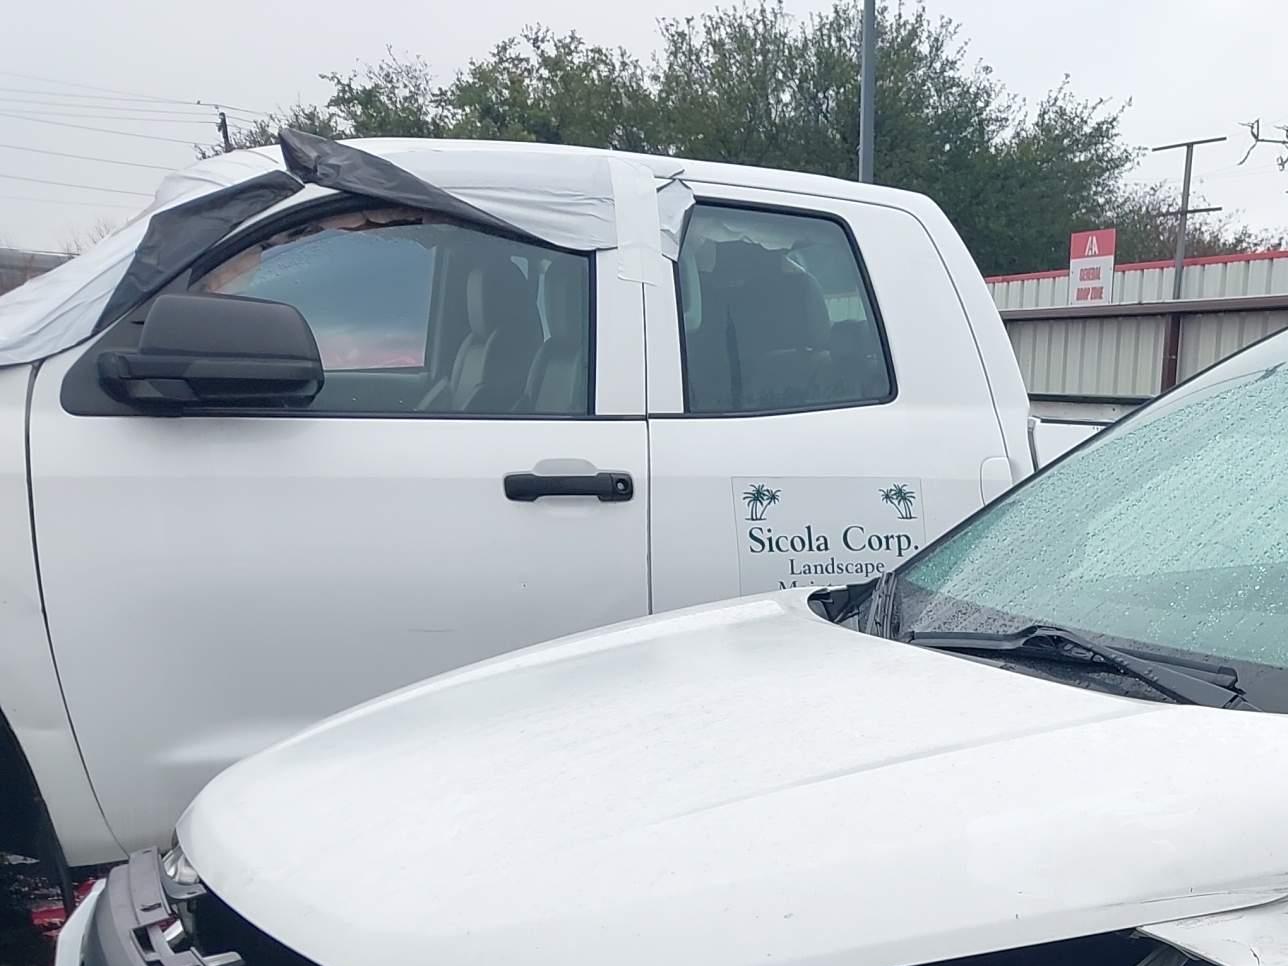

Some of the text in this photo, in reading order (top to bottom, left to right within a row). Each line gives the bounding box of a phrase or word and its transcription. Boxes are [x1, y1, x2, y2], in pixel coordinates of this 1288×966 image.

[749, 525, 919, 557] Sicola Corp.
[789, 557, 885, 577] Landscape
